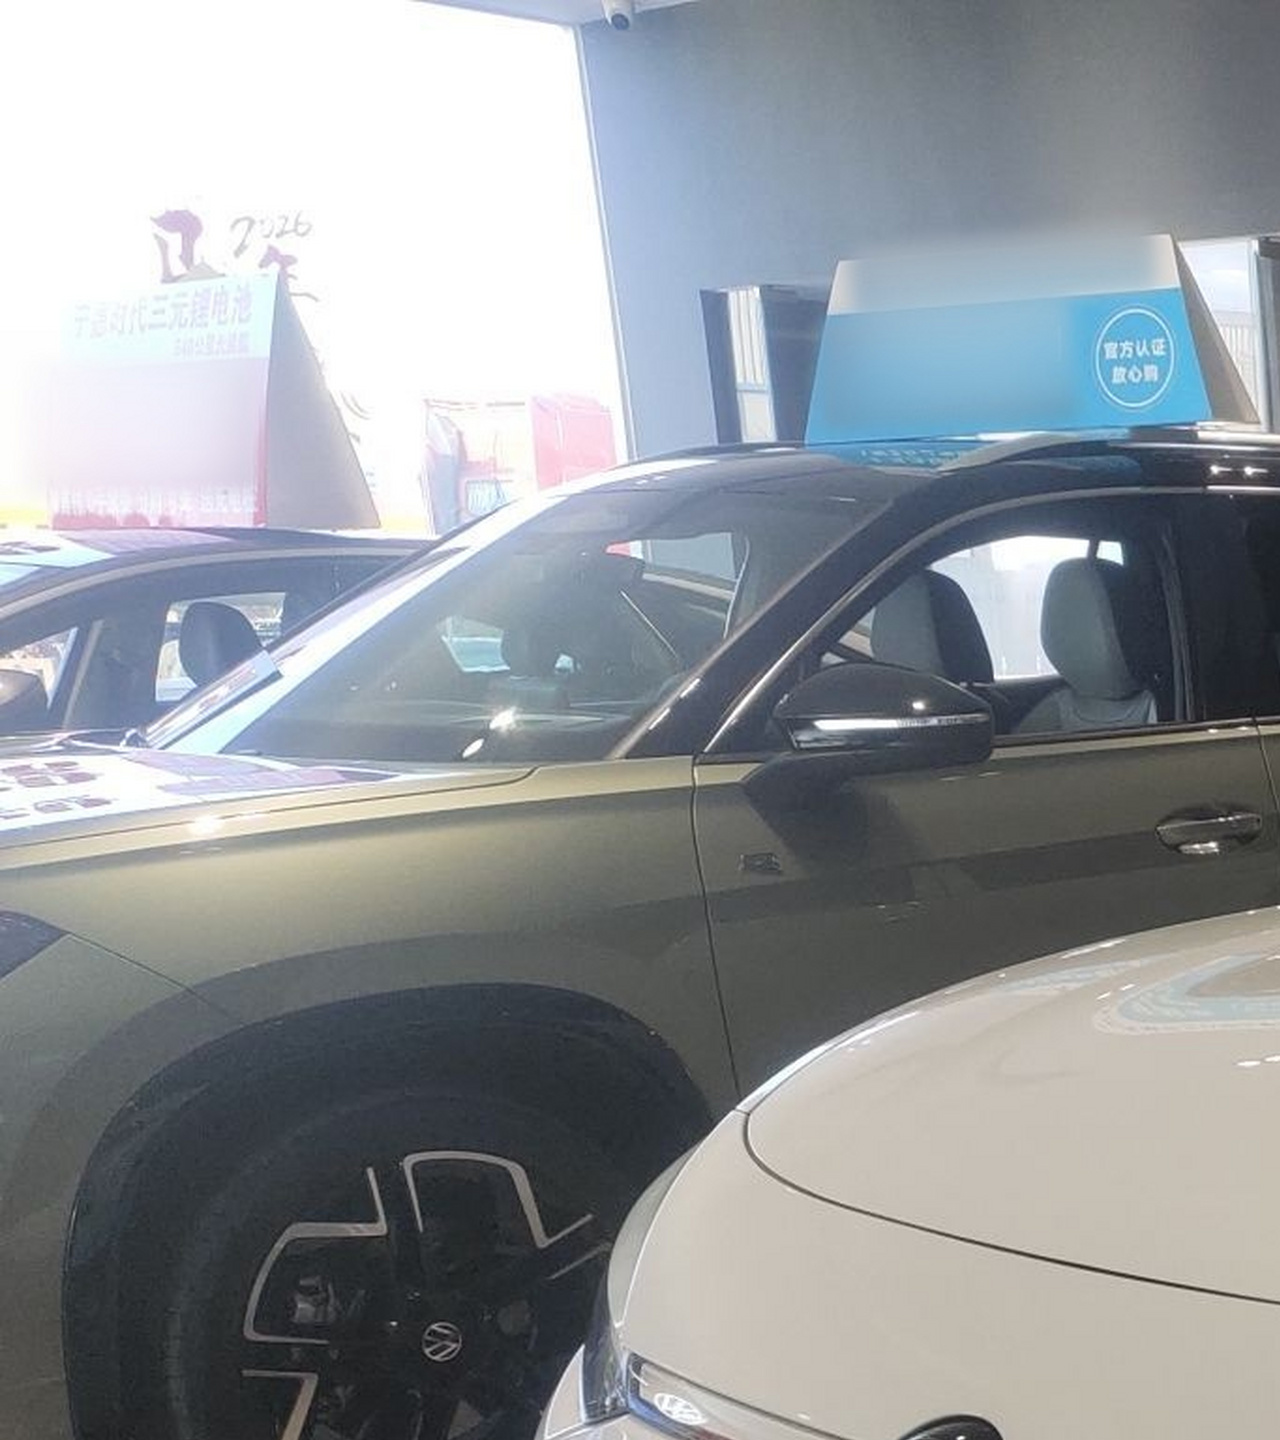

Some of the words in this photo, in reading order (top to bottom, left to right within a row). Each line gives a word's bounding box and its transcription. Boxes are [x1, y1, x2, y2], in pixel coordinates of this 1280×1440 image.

[1103, 339, 1166, 360] 官方认证
[1111, 364, 1158, 384] 放心购
